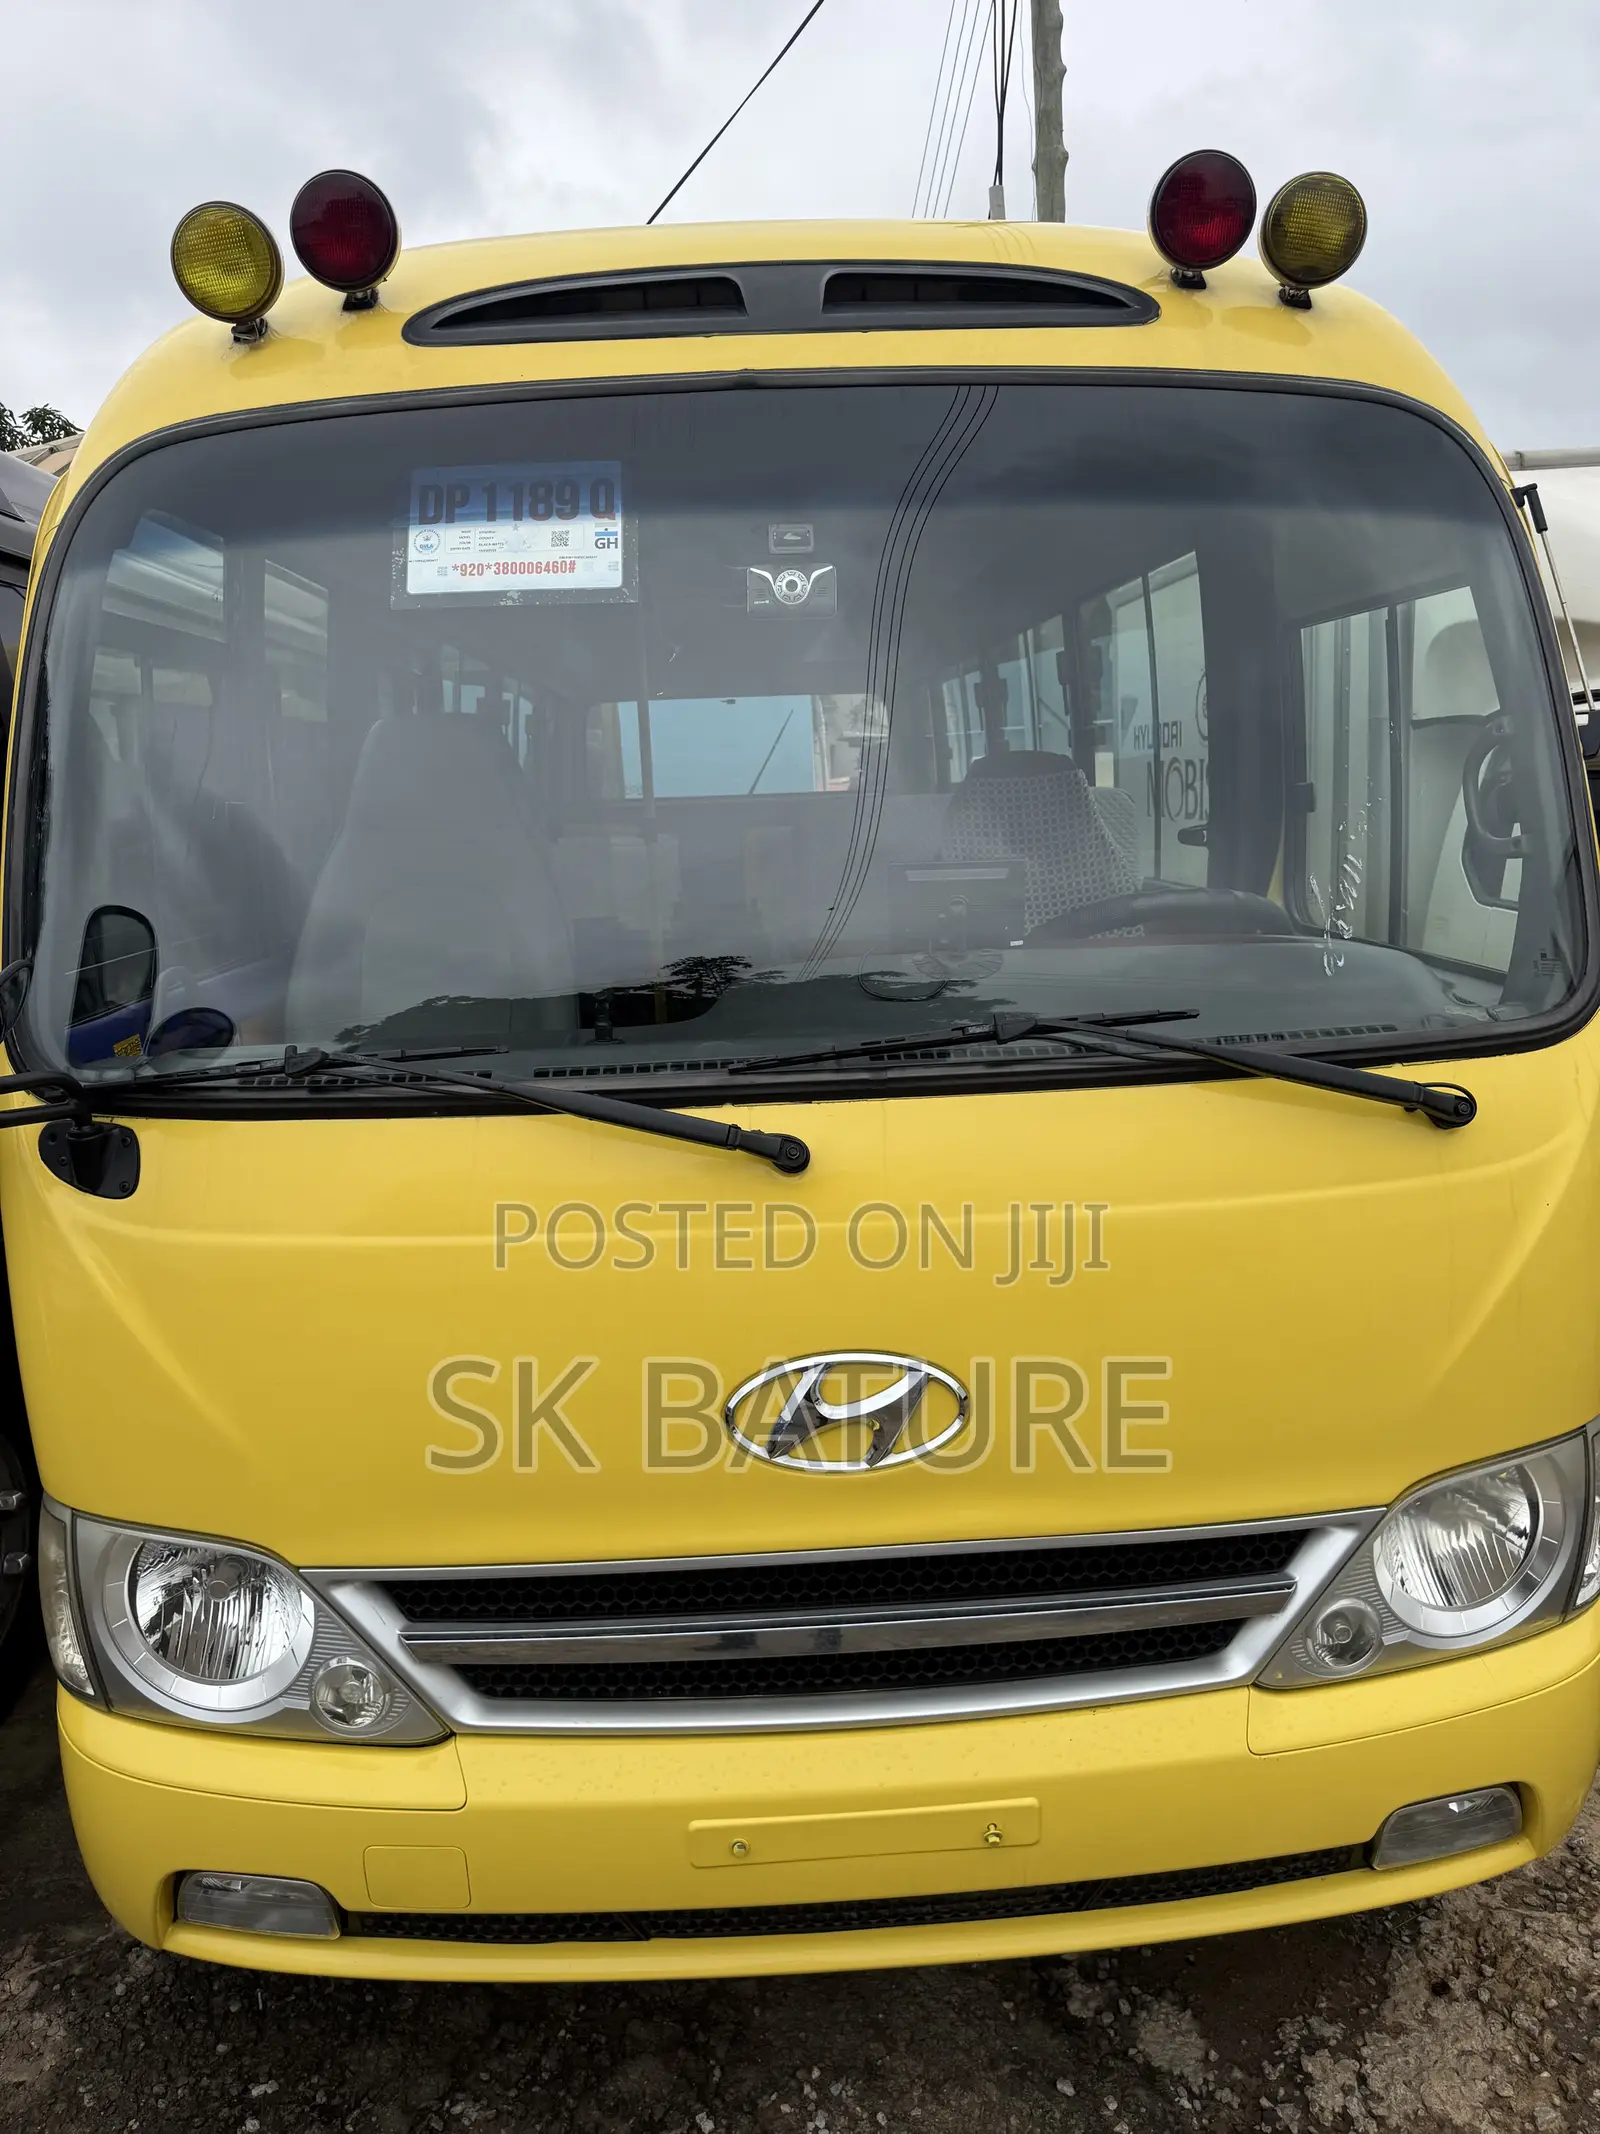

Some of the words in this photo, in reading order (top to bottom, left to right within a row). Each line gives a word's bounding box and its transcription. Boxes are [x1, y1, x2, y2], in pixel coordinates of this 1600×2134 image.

[418, 483, 470, 525] DP
[482, 479, 580, 522] 1189
[590, 477, 616, 521] Q
[594, 537, 619, 549] GH
